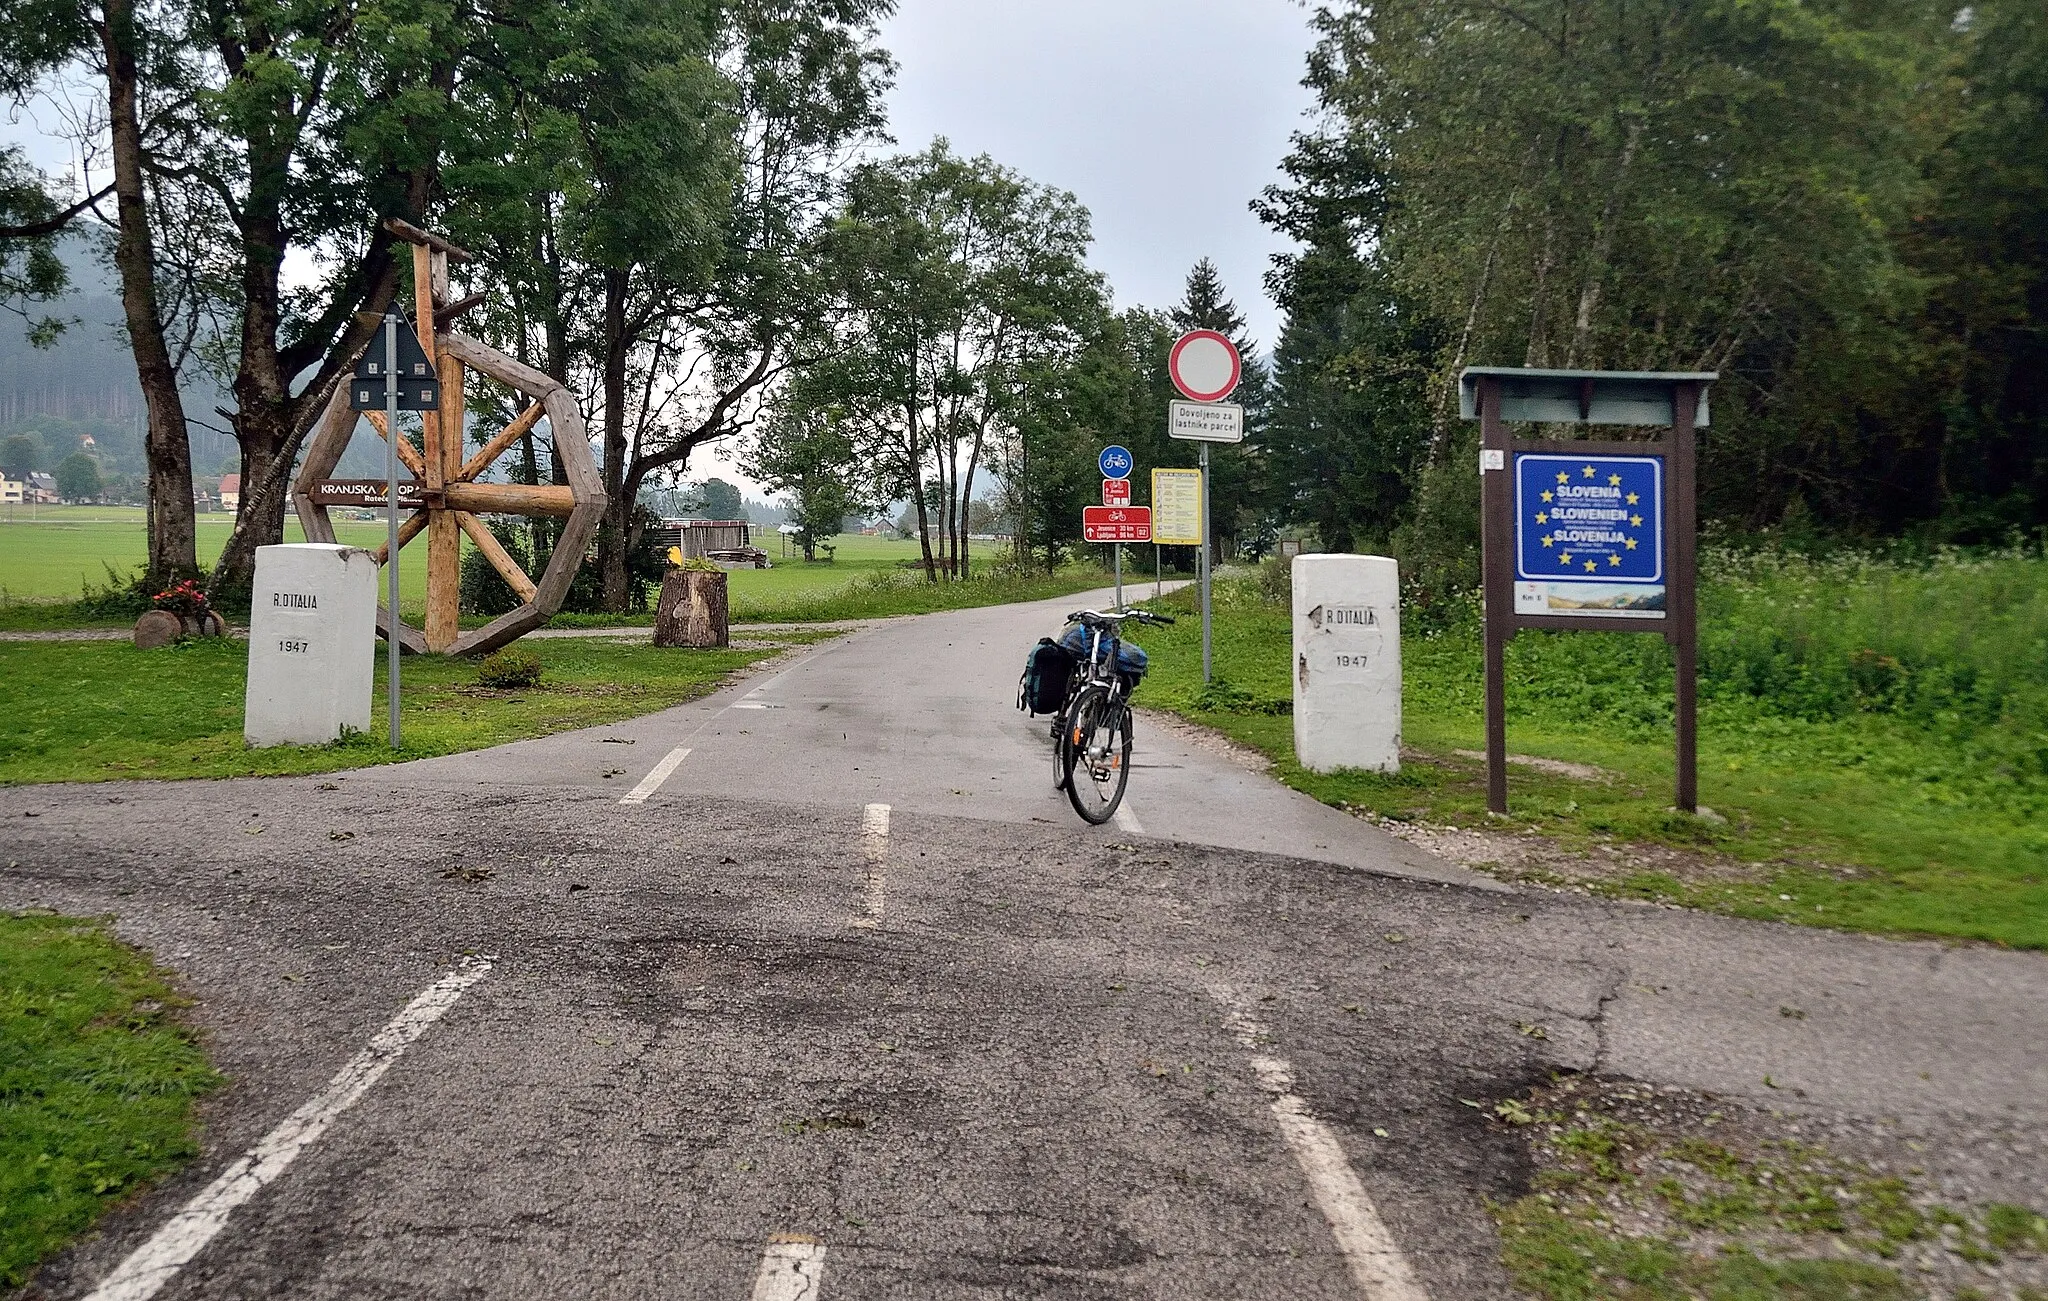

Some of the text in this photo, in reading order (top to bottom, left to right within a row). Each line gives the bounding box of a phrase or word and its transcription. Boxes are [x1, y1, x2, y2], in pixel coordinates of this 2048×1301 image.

[1179, 407, 1233, 420] Dovoljeno za
[1175, 419, 1236, 432] lastnike parcel
[321, 484, 377, 495] KRANJSKA
[1556, 485, 1622, 498] SLOVENIA
[1550, 507, 1628, 521] SLOWENIEN
[1553, 529, 1626, 543] SLOVENIJA
[279, 641, 308, 653] 1947
[1336, 655, 1368, 668] 1947
